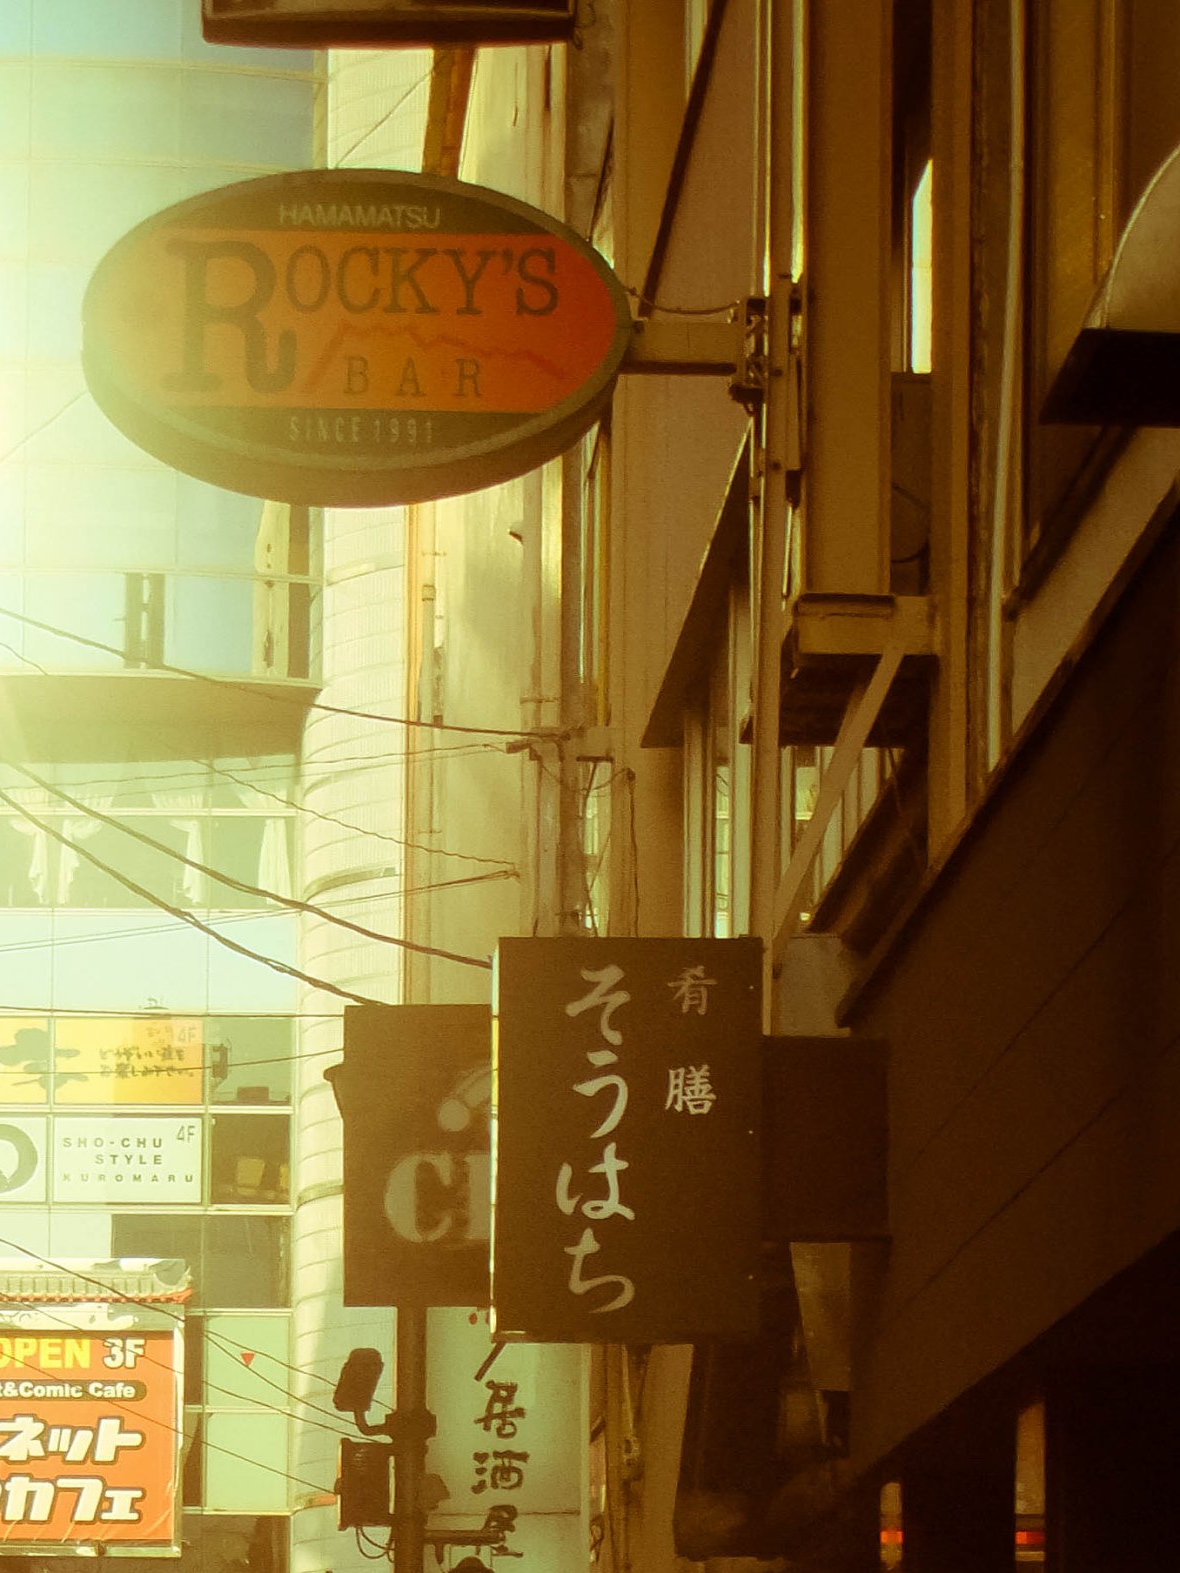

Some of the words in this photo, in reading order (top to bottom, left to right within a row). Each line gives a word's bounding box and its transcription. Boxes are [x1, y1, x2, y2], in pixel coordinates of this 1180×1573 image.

[279, 203, 440, 229] HAMAMATSU
[160, 239, 559, 394] ROCKY'S
[343, 357, 483, 398] BAR
[289, 416, 360, 442] SINCE
[374, 419, 433, 444] 1991
[176, 1027, 197, 1043] 4F
[63, 1136, 163, 1149] SHO-CHU
[176, 1124, 196, 1142] 4F
[556, 964, 636, 1314] そうはち
[95, 1153, 163, 1166] STYLE
[63, 1172, 194, 1184] KUROMARU
[103, 1338, 146, 1370] 3F
[89, 1382, 136, 1398] Cafe
[474, 1380, 531, 1558] 居酒屋
